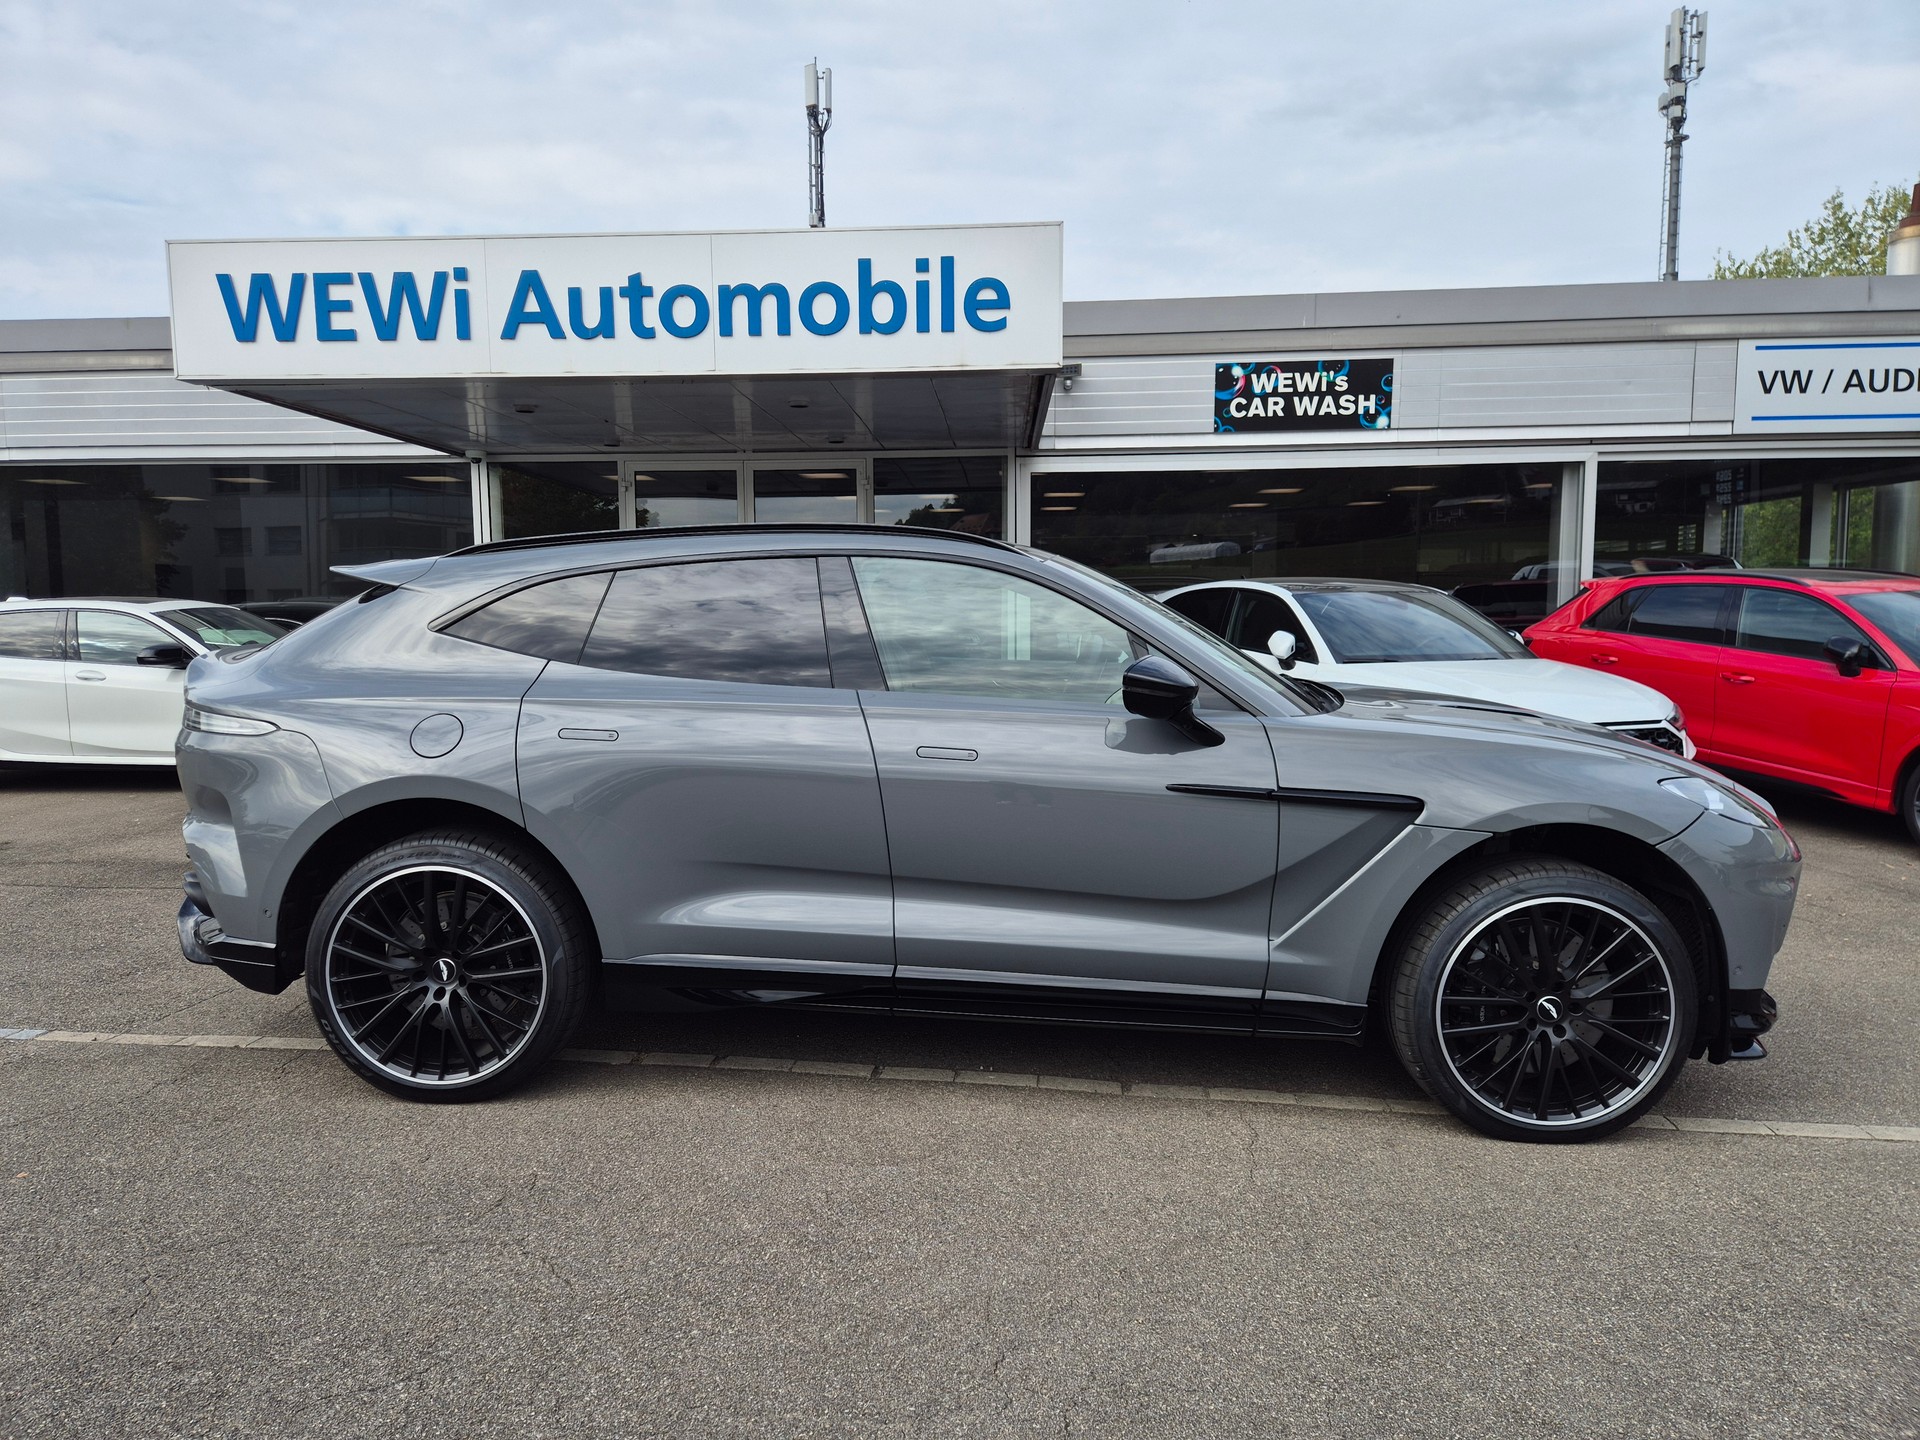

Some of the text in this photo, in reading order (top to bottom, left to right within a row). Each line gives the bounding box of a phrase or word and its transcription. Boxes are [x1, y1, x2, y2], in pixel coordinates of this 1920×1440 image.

[215, 255, 1012, 343] WEWi Automobile
[1251, 370, 1349, 394] WEWi's
[1757, 370, 1814, 395] VW
[1821, 368, 1834, 394] /
[1229, 394, 1376, 418] CAR WASH
